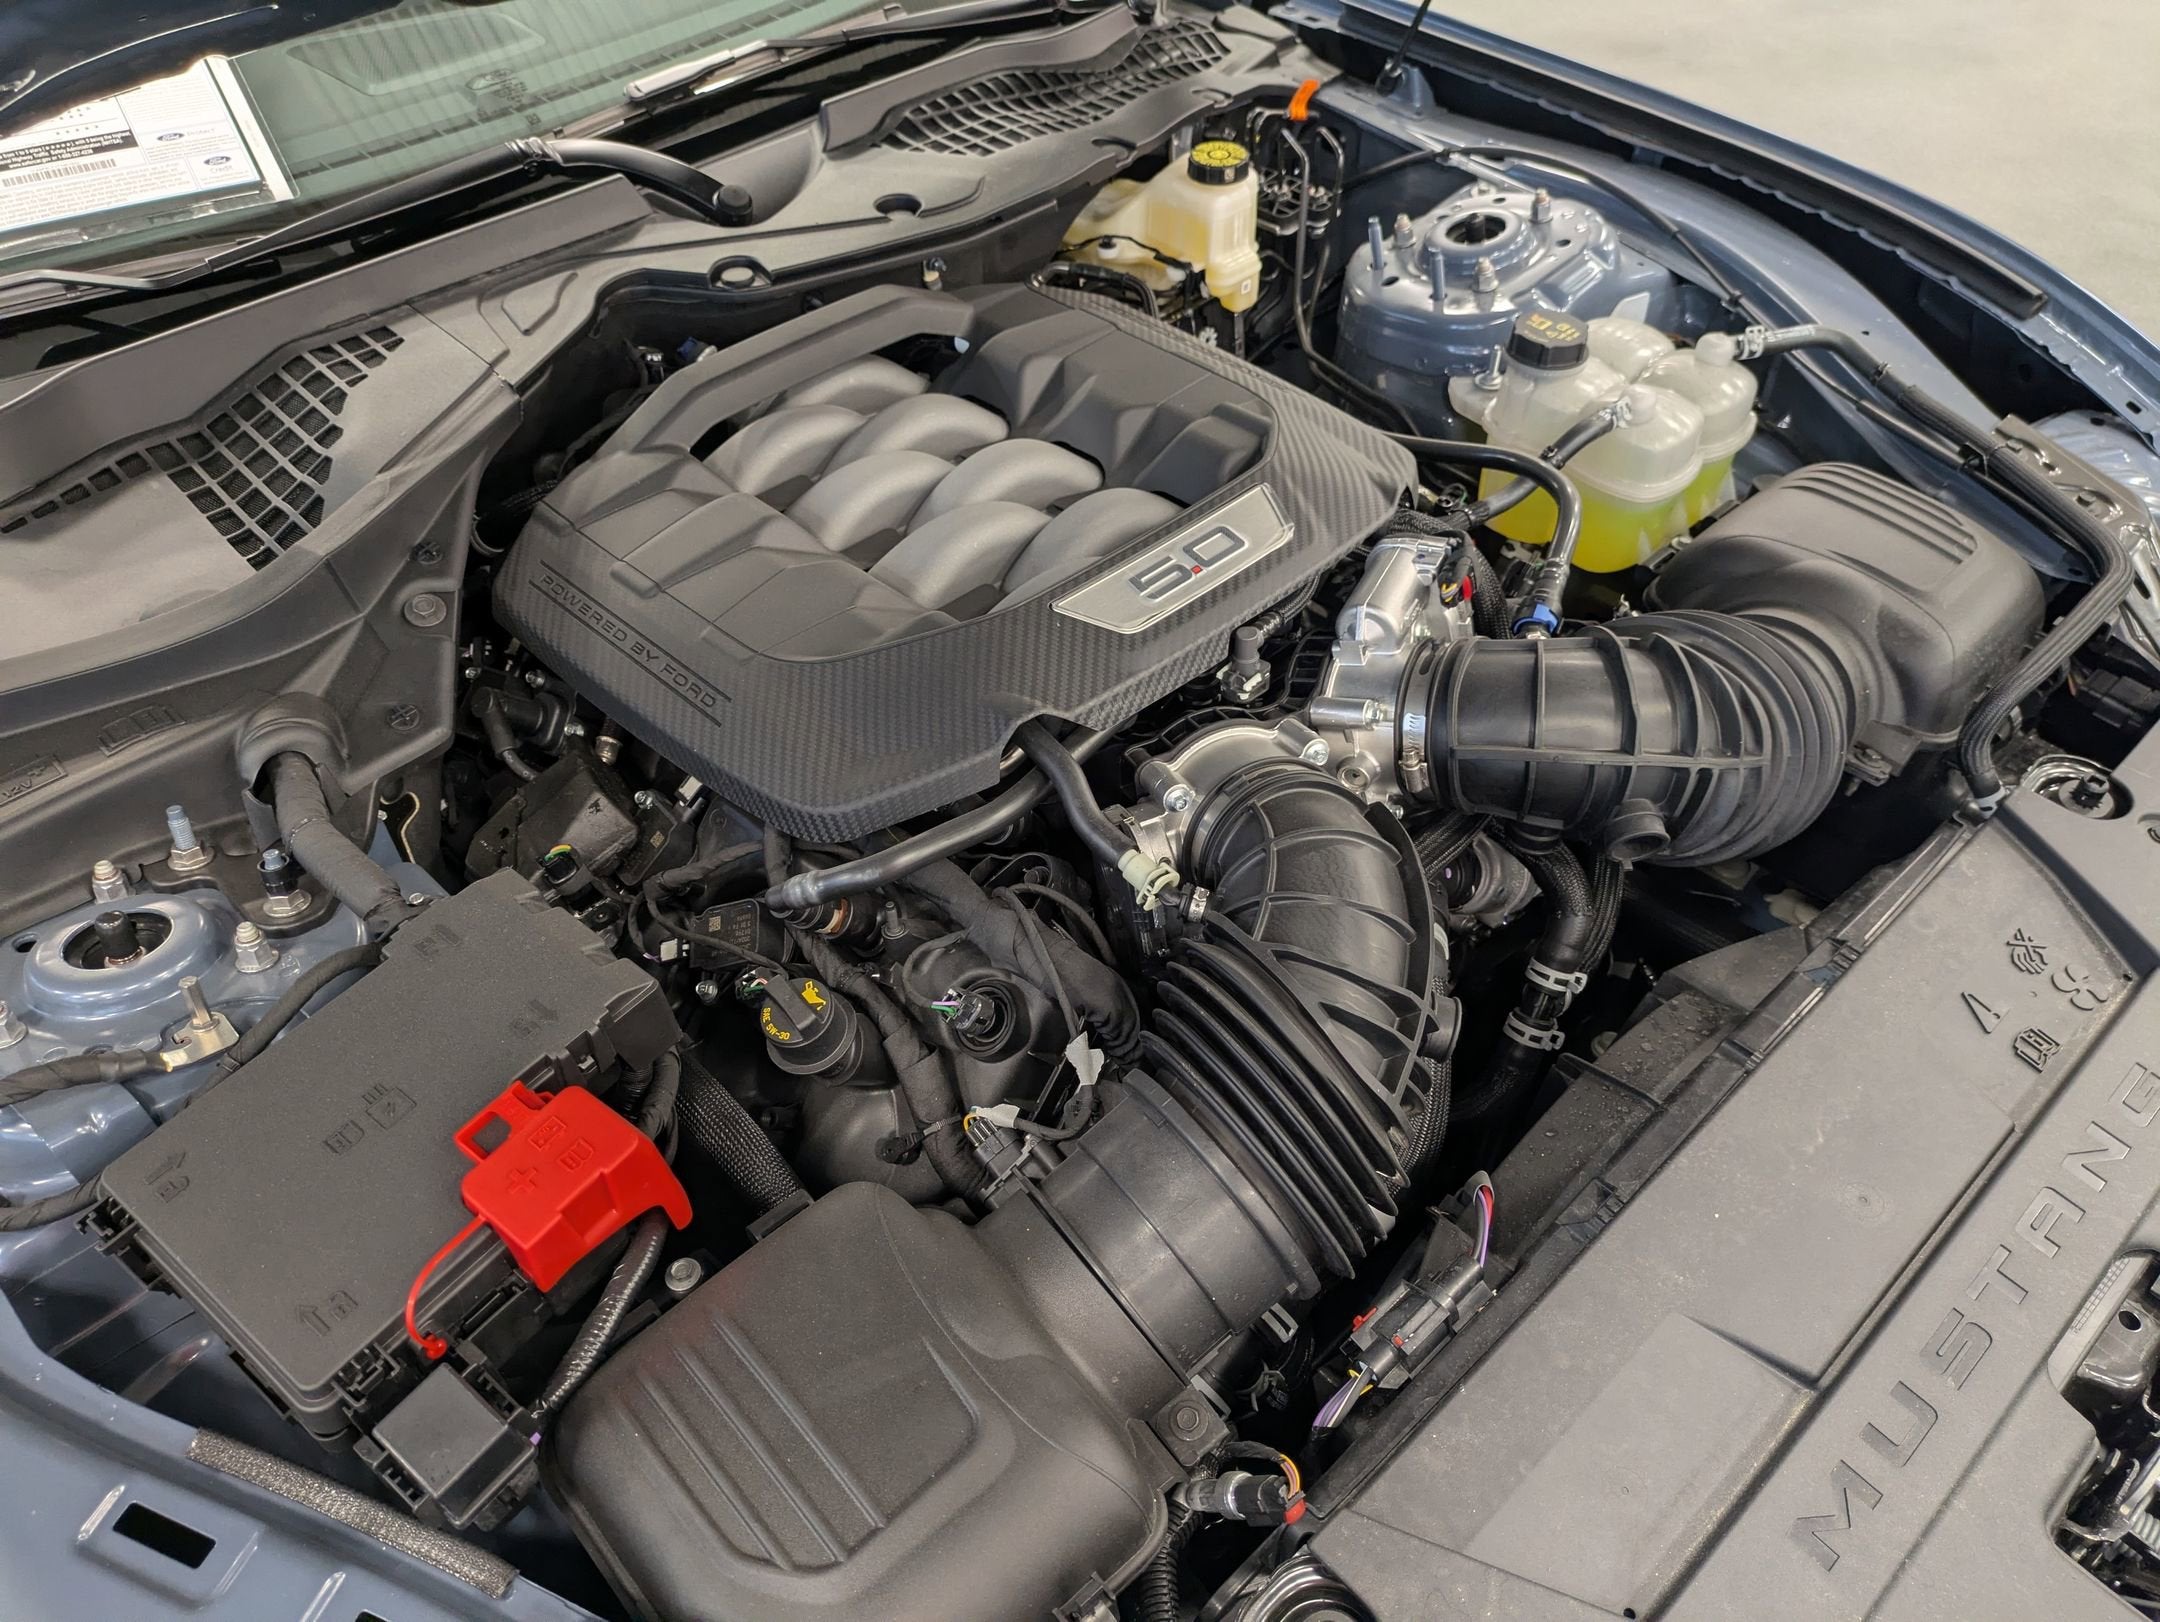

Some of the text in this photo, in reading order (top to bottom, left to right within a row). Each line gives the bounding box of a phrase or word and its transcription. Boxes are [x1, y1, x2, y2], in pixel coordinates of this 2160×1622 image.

[1128, 525, 1247, 600] 5.0
[540, 574, 717, 708] POWERED BY FORD
[762, 1007, 790, 1040] SAE 5W-30
[1790, 1062, 2160, 1572] MUSTANG
